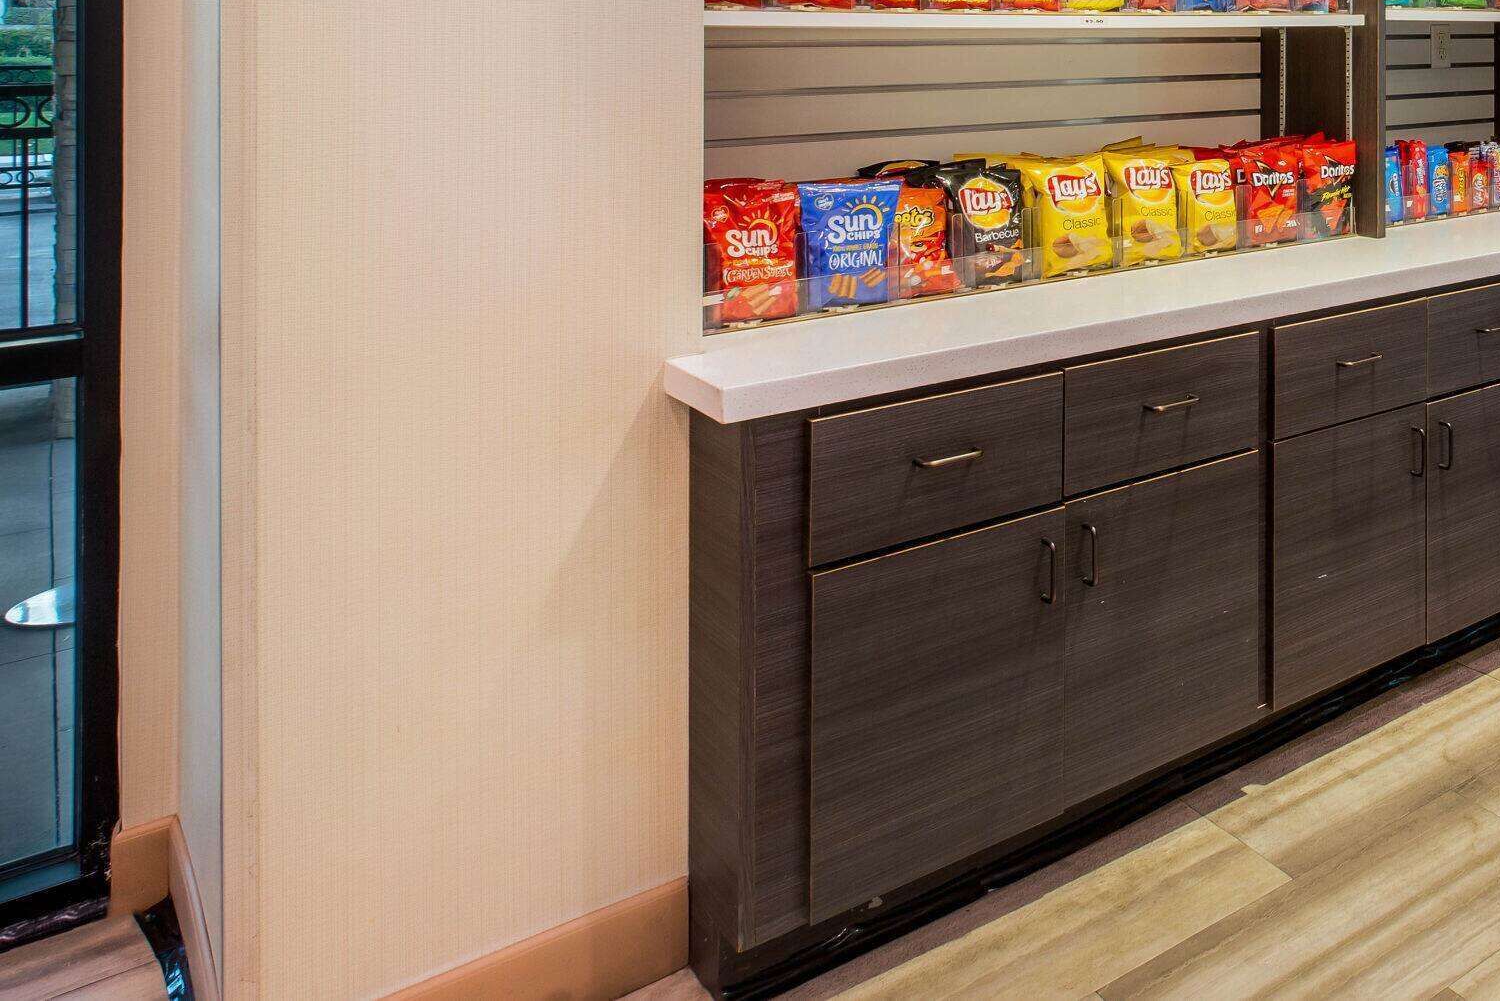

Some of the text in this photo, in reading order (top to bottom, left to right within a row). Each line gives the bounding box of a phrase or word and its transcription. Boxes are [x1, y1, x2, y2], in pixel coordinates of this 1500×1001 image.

[1252, 171, 1294, 186] Doritos
[1320, 164, 1355, 179] Doritos
[894, 207, 935, 227] eetos
[1140, 206, 1172, 217] Classic
[1204, 209, 1236, 221] Classi
[1062, 217, 1101, 231] Classic
[846, 229, 881, 242] CHIPS
[975, 228, 1020, 243] Barbecue
